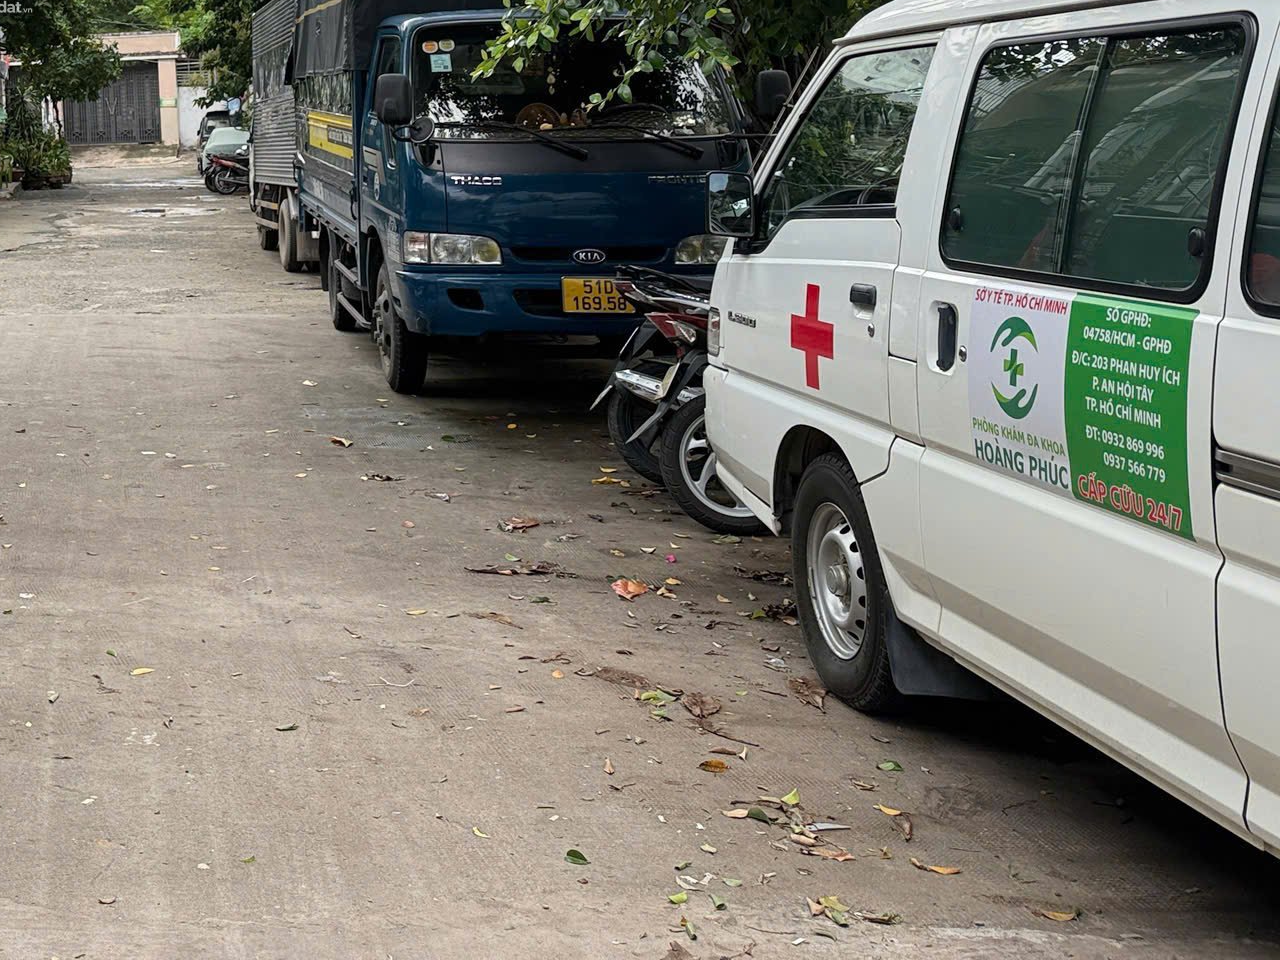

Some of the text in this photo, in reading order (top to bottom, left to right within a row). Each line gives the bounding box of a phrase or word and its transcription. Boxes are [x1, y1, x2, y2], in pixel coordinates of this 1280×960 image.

[579, 252, 600, 260] KIA
[583, 279, 614, 294] 51D
[573, 296, 627, 311] 169.58
[1044, 299, 1068, 315] MINH
[1083, 325, 1136, 348] 04758/HCM
[1142, 336, 1173, 355] GPHĐ
[1071, 349, 1091, 368] Đ/C:
[1091, 354, 1108, 370] 203
[1110, 357, 1137, 377] PHAN
[1139, 363, 1161, 382] HUY
[1092, 376, 1100, 391] P.
[1101, 378, 1116, 395] AN
[1135, 384, 1155, 404] TÂY
[1084, 395, 1098, 413] TP.
[1115, 403, 1133, 421] CHÍ
[1134, 408, 1161, 429] MINH
[1040, 437, 1066, 457] KHOA
[1102, 429, 1125, 449] 0932
[1126, 436, 1144, 454] 869
[1145, 441, 1165, 460] 996
[974, 437, 1069, 490] HOÀNG PHÚC
[1103, 452, 1166, 483] 0937 566 779
[1077, 471, 1182, 531] CẤP CỨU 24/7
